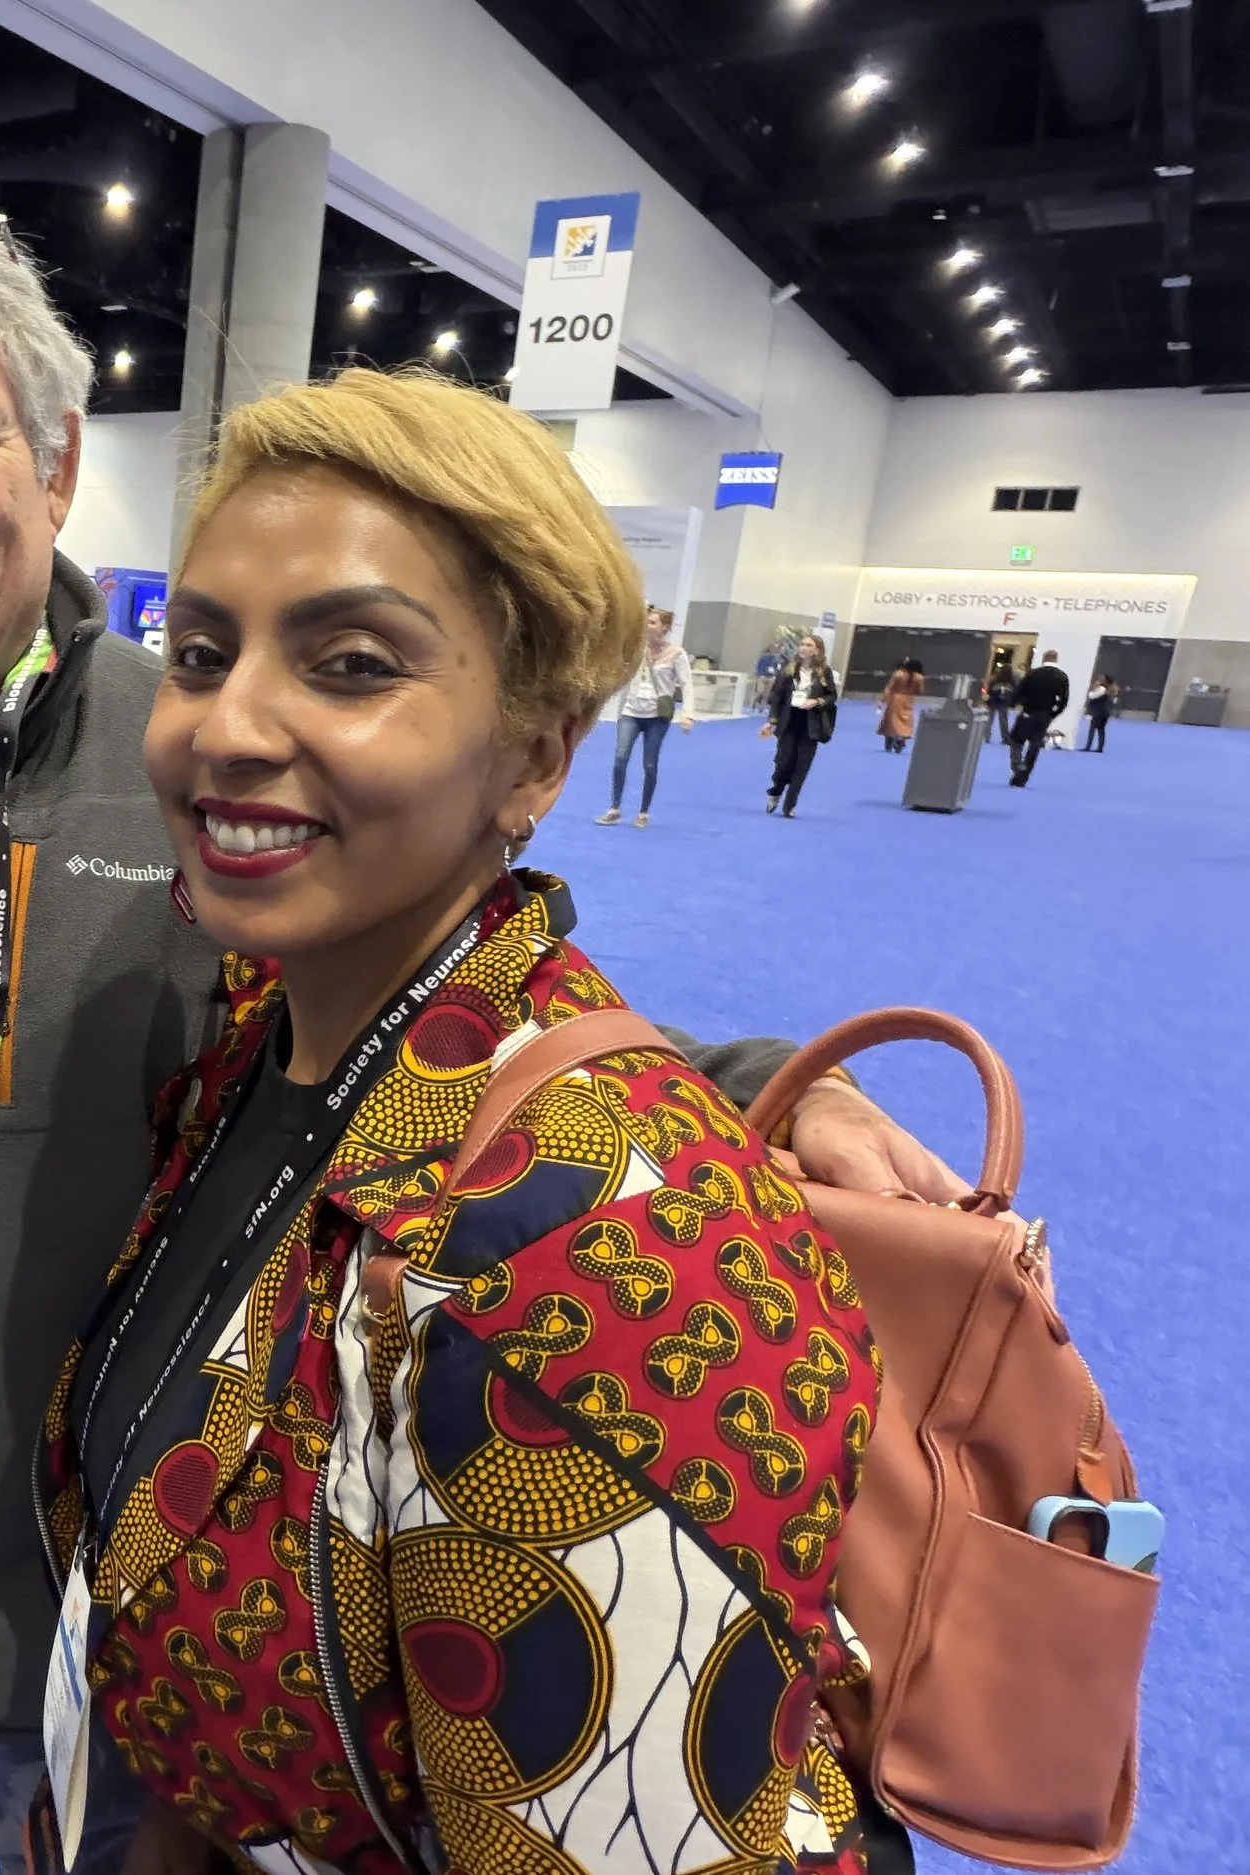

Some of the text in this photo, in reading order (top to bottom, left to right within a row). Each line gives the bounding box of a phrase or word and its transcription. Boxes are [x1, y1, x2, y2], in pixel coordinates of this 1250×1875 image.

[529, 313, 613, 343] 1200
[719, 467, 778, 484] ZEISS
[873, 591, 1168, 614] LOBBY RESTROOMS TELEPHONES
[1002, 611, 1018, 626] F
[89, 857, 175, 882] Columbia
[326, 1033, 384, 1111] Society
[380, 1001, 410, 1032] for
[245, 1165, 295, 1239] SfN.org
[135, 1236, 169, 1303] Society
[118, 1307, 135, 1335] for
[138, 1292, 210, 1421] Neuroscience
